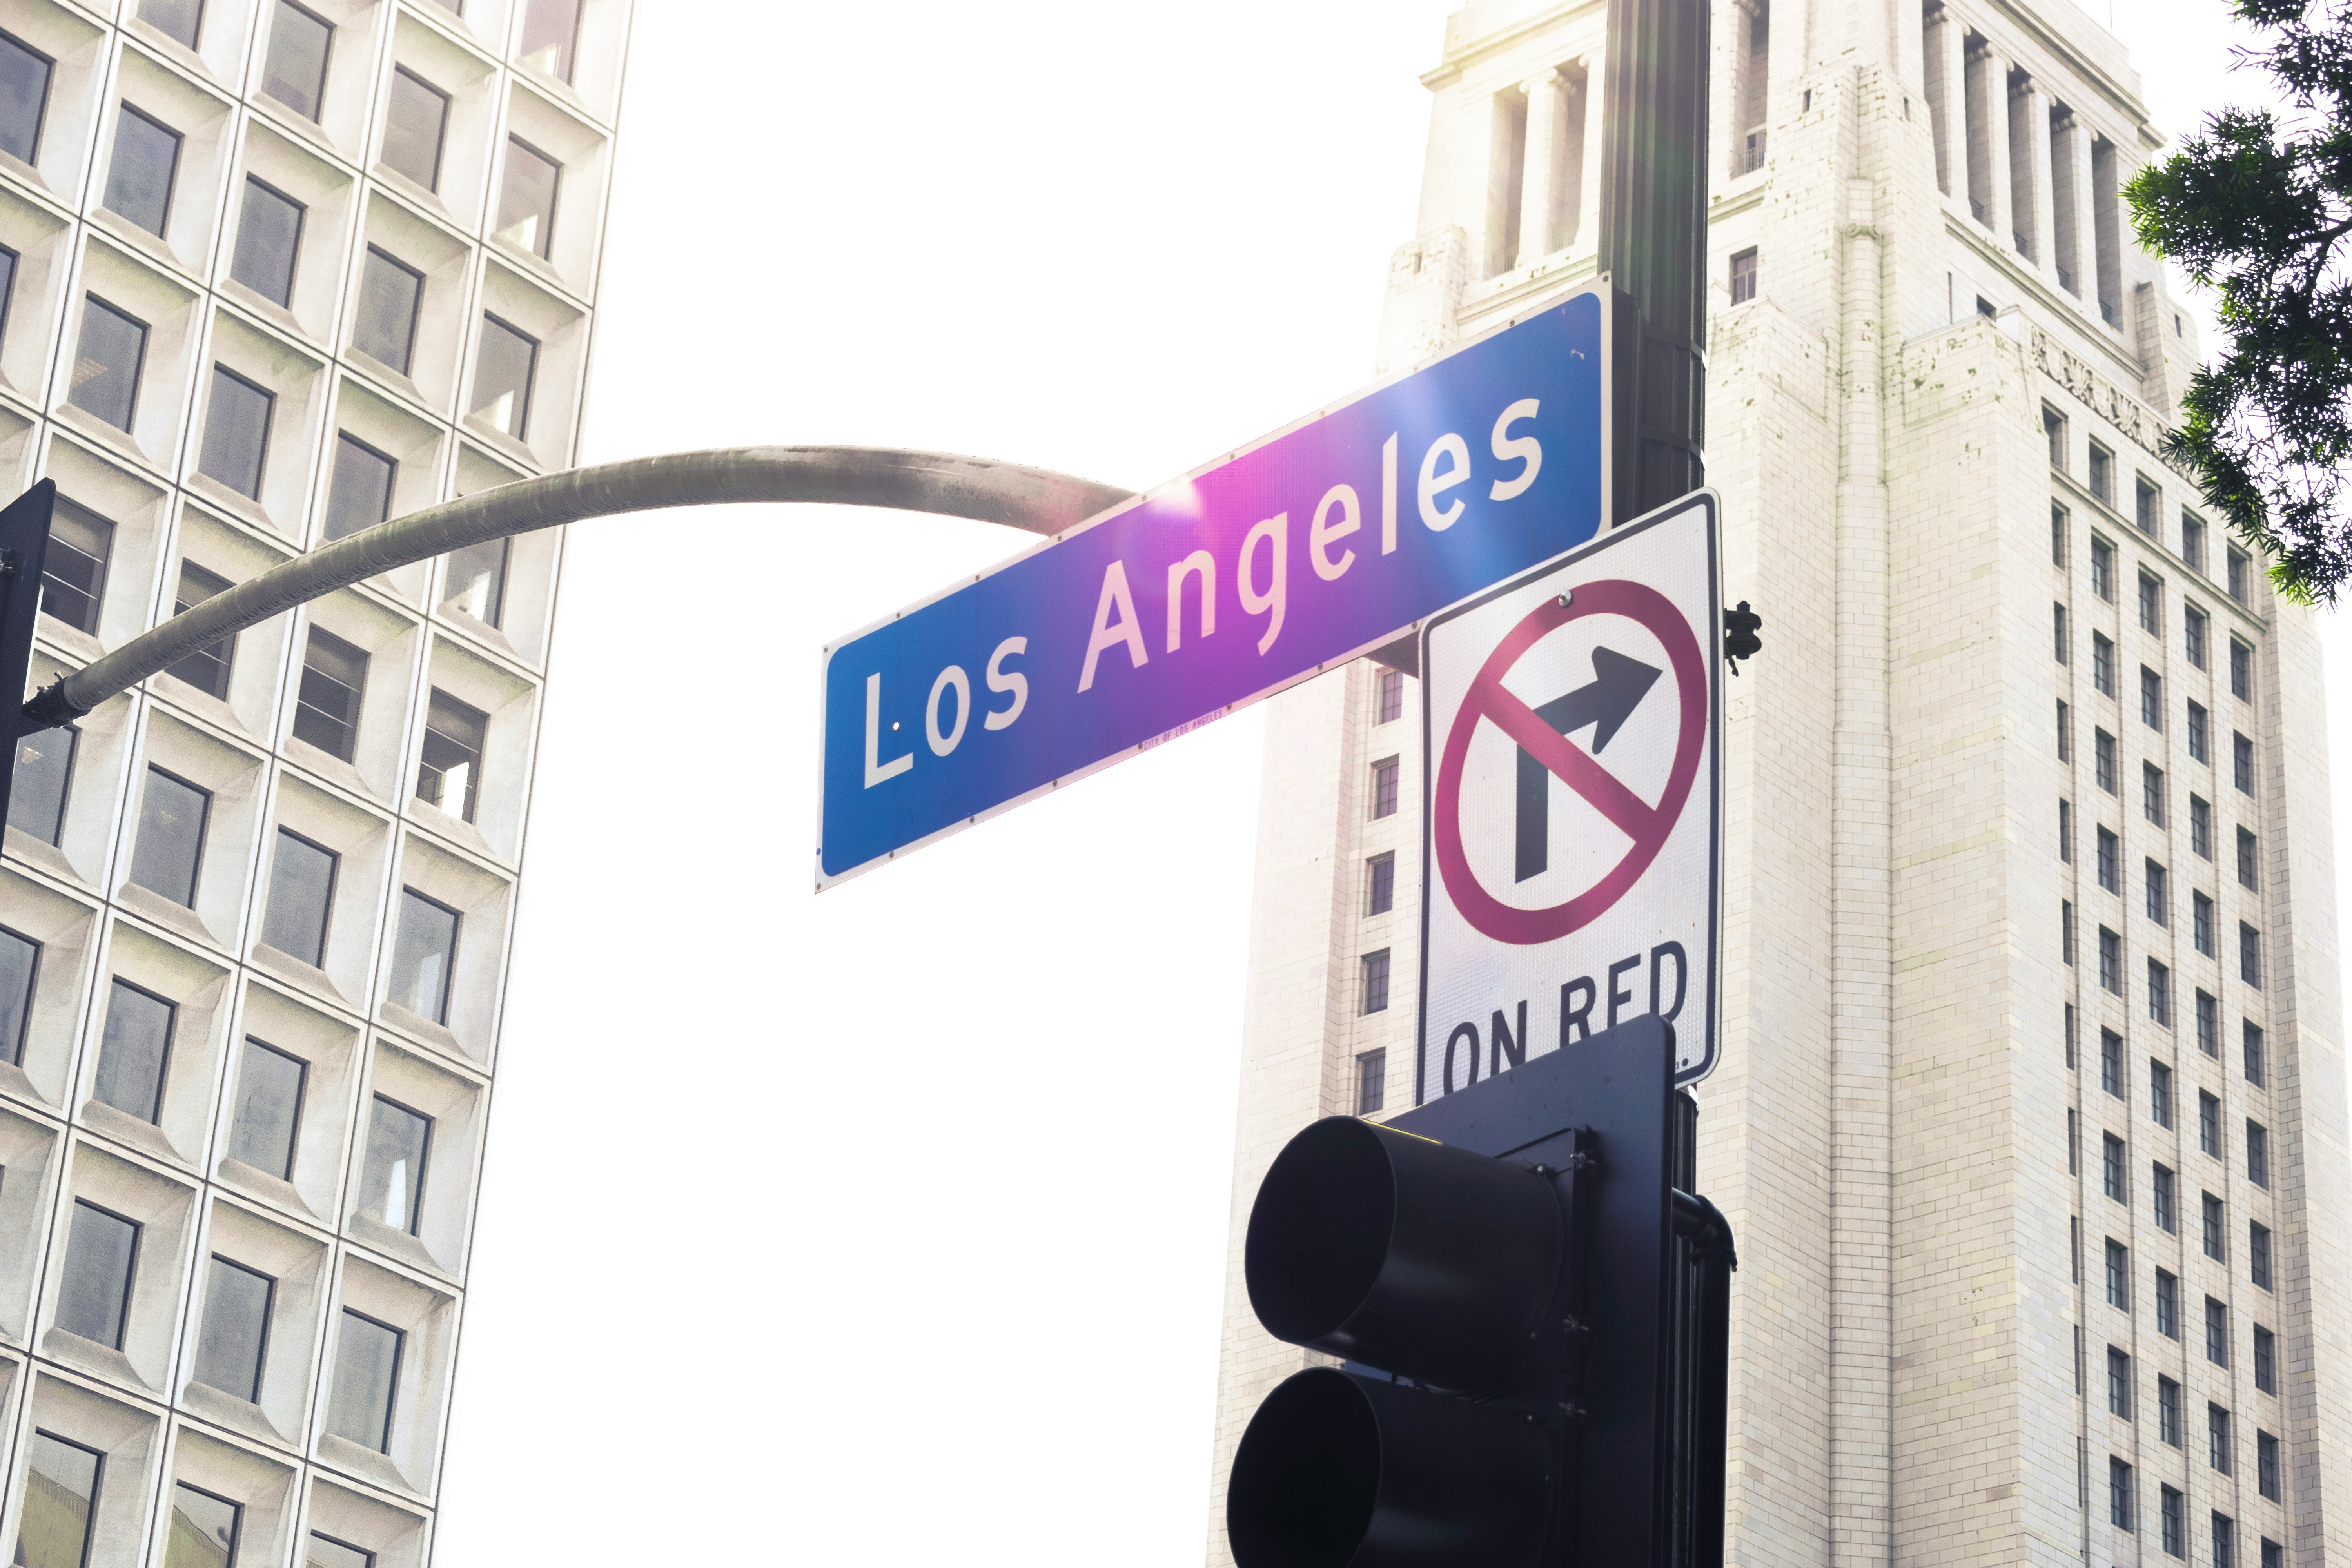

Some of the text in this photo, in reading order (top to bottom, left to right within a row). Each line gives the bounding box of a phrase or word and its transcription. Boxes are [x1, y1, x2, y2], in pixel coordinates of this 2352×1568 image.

[864, 397, 1543, 789] Los Angeles
[1144, 710, 1223, 750] CITY OF LOS ANGELES
[1443, 940, 1686, 1096] ON RED
